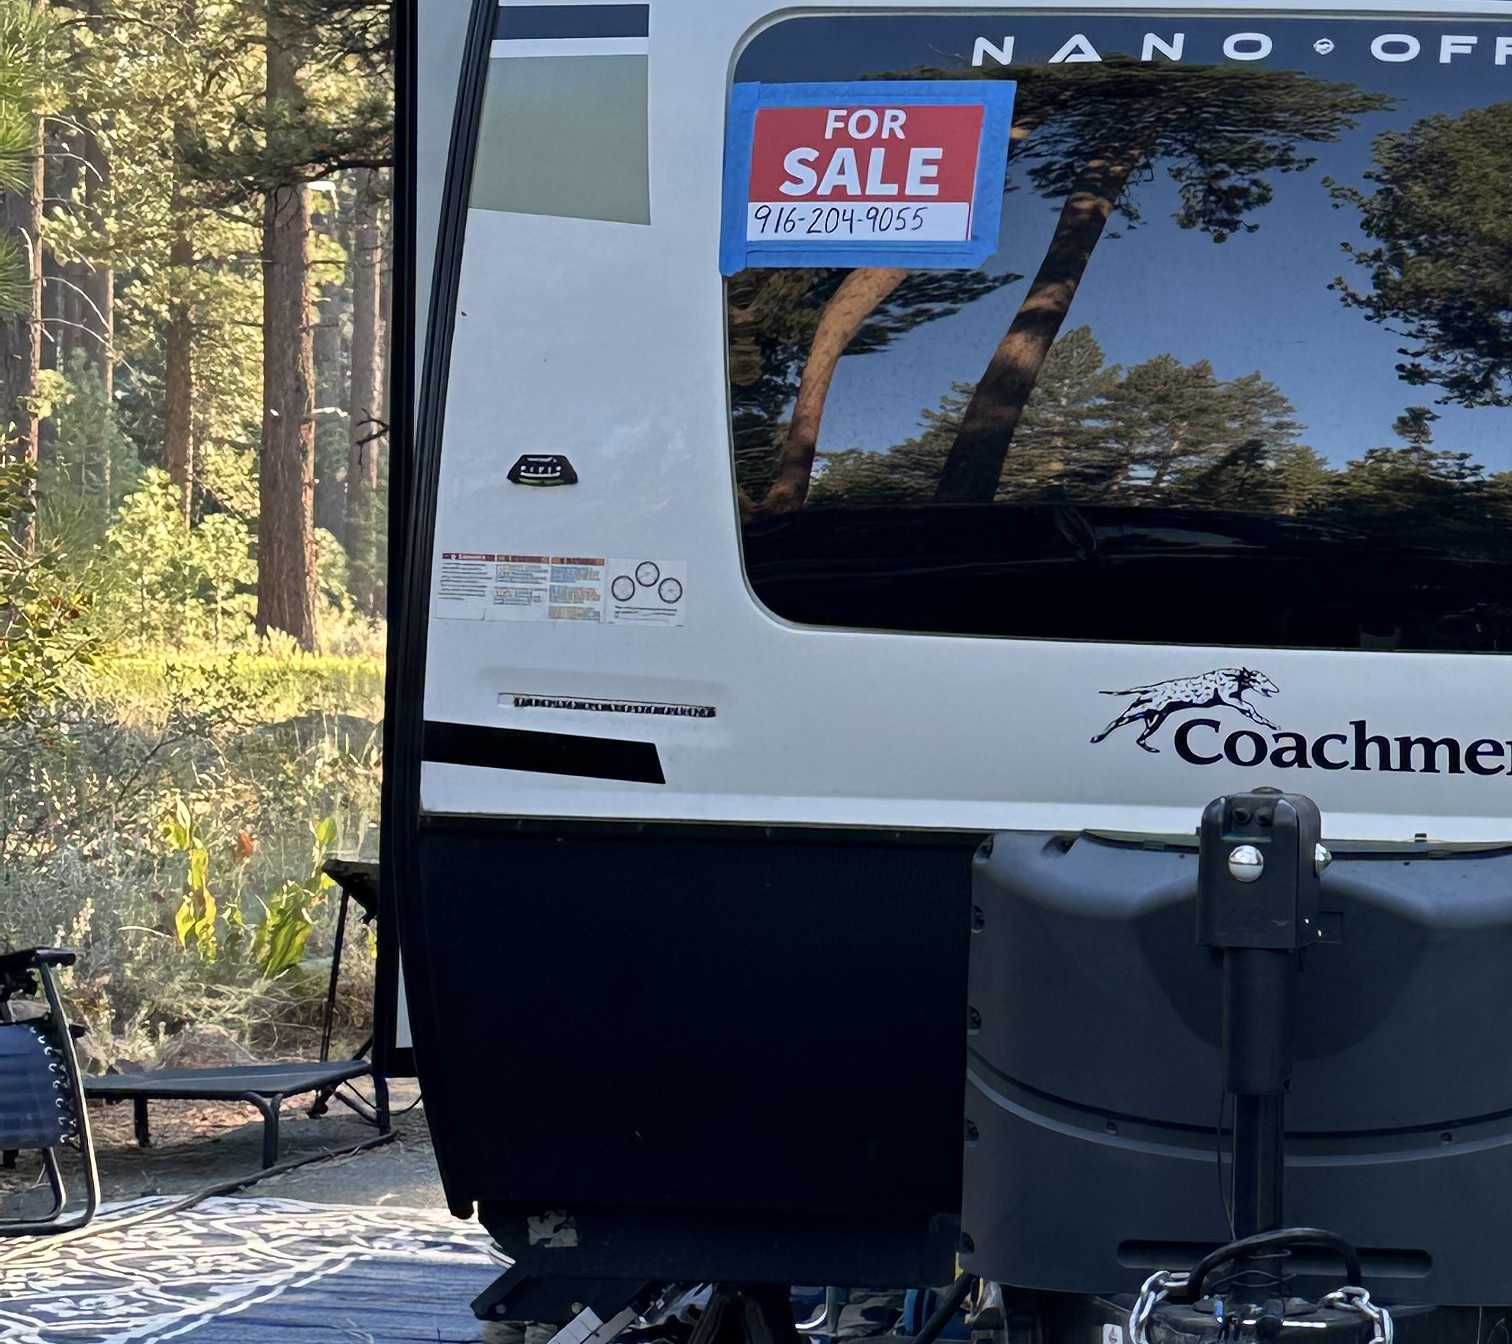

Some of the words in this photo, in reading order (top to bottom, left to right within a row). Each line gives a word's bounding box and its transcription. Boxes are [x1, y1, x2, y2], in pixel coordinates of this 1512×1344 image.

[972, 31, 1272, 67] NANO
[825, 109, 907, 140] FOR
[778, 147, 943, 196] SALE
[754, 205, 928, 234] 916-204-9055
